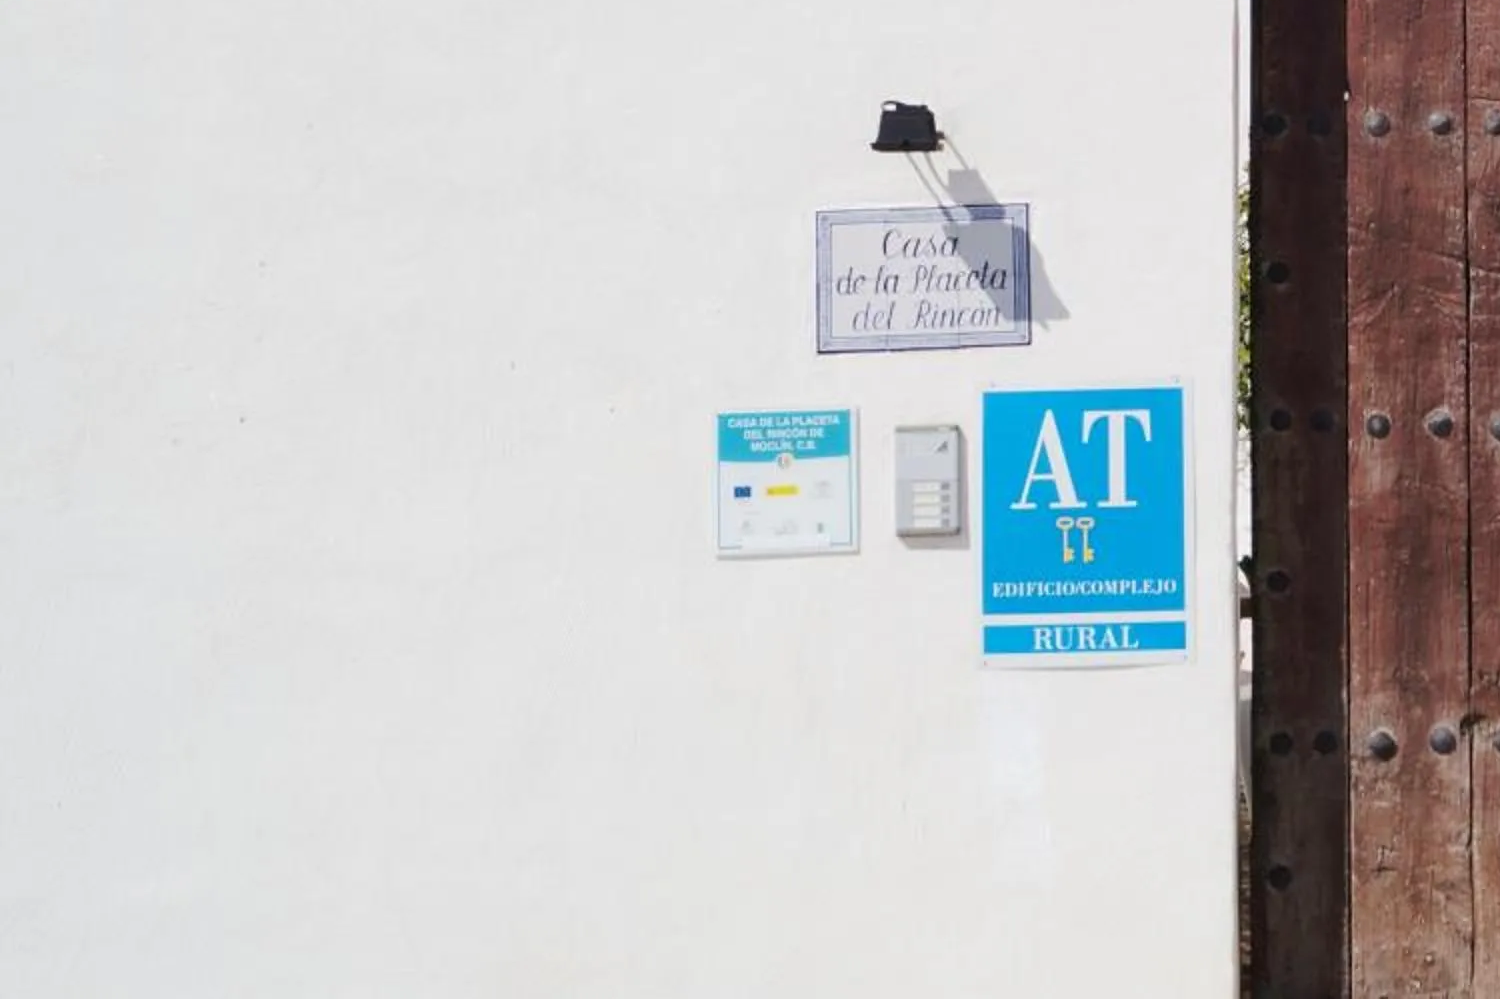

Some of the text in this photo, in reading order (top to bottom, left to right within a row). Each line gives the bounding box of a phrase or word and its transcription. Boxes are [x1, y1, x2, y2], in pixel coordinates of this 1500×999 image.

[882, 229, 959, 259] Casa
[836, 260, 1007, 295] de la Placeta
[852, 301, 896, 331] del
[727, 417, 757, 428] CASA
[759, 417, 774, 427] DE
[776, 416, 790, 426] LA
[743, 429, 763, 440] DEL
[809, 427, 824, 438] DE
[1010, 408, 1152, 510] AT
[992, 578, 1177, 598] EDIFICIO/COMPLEJO
[1033, 625, 1139, 651] RURAL
